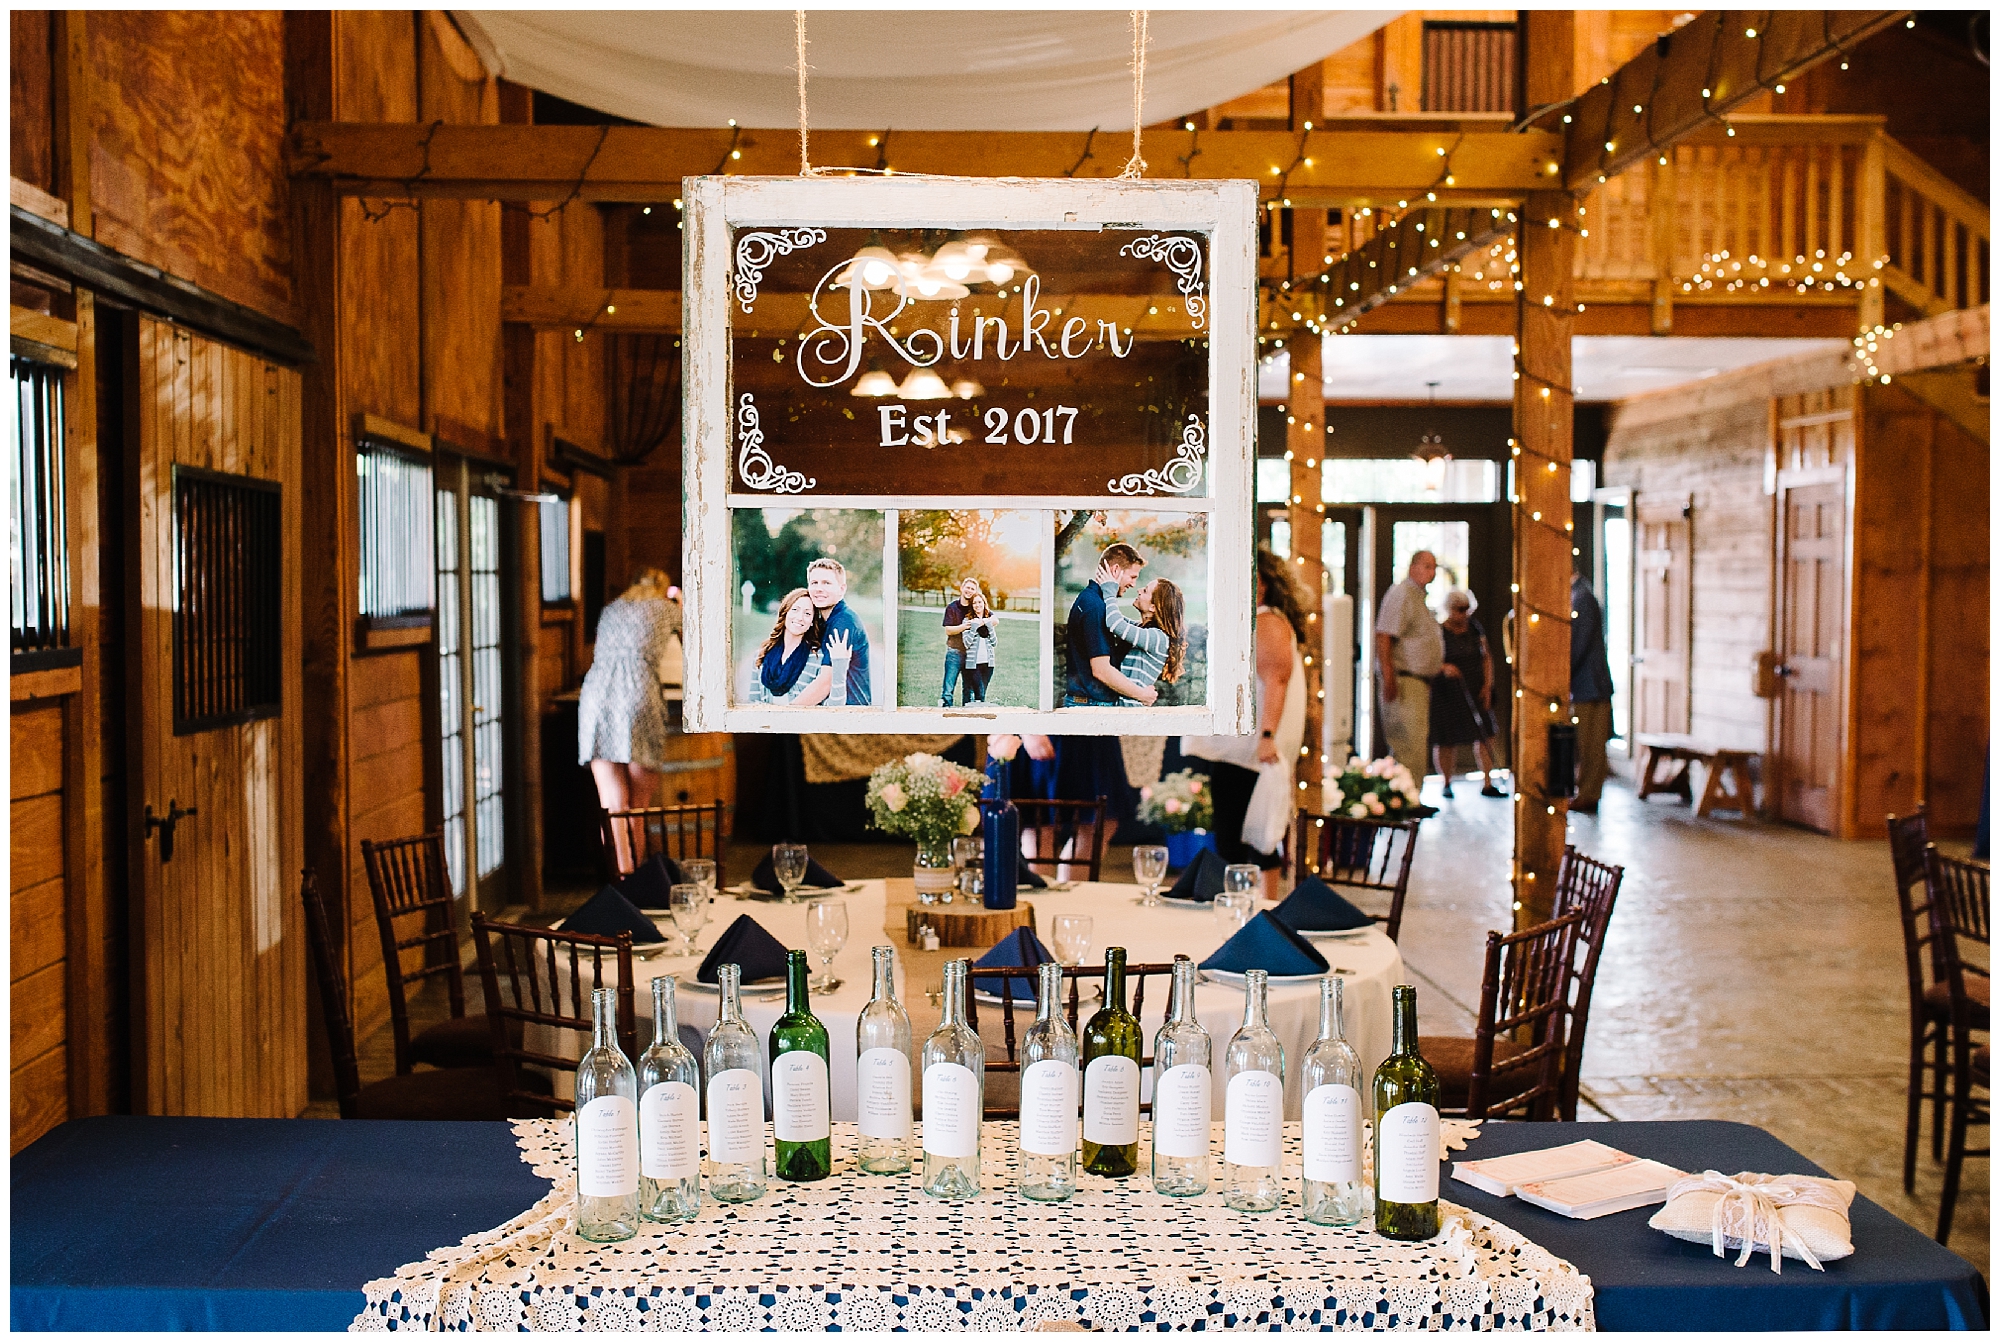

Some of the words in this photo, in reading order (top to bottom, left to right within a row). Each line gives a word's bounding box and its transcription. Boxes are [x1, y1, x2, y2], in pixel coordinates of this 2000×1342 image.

[797, 256, 1134, 388] Rinker
[877, 405, 962, 447] Est.
[983, 406, 1079, 446] 2017
[873, 1059, 887, 1067] Table
[1104, 1065, 1119, 1073] Table
[937, 1074, 952, 1083] Table
[1042, 1070, 1057, 1079] Table
[1180, 1071, 1196, 1080] Table
[726, 1084, 741, 1092] Table
[1246, 1079, 1262, 1088] Table
[660, 1093, 676, 1102] Table
[1323, 1097, 1339, 1106] Table
[599, 1110, 615, 1118] Table
[1403, 1116, 1419, 1125] Table
